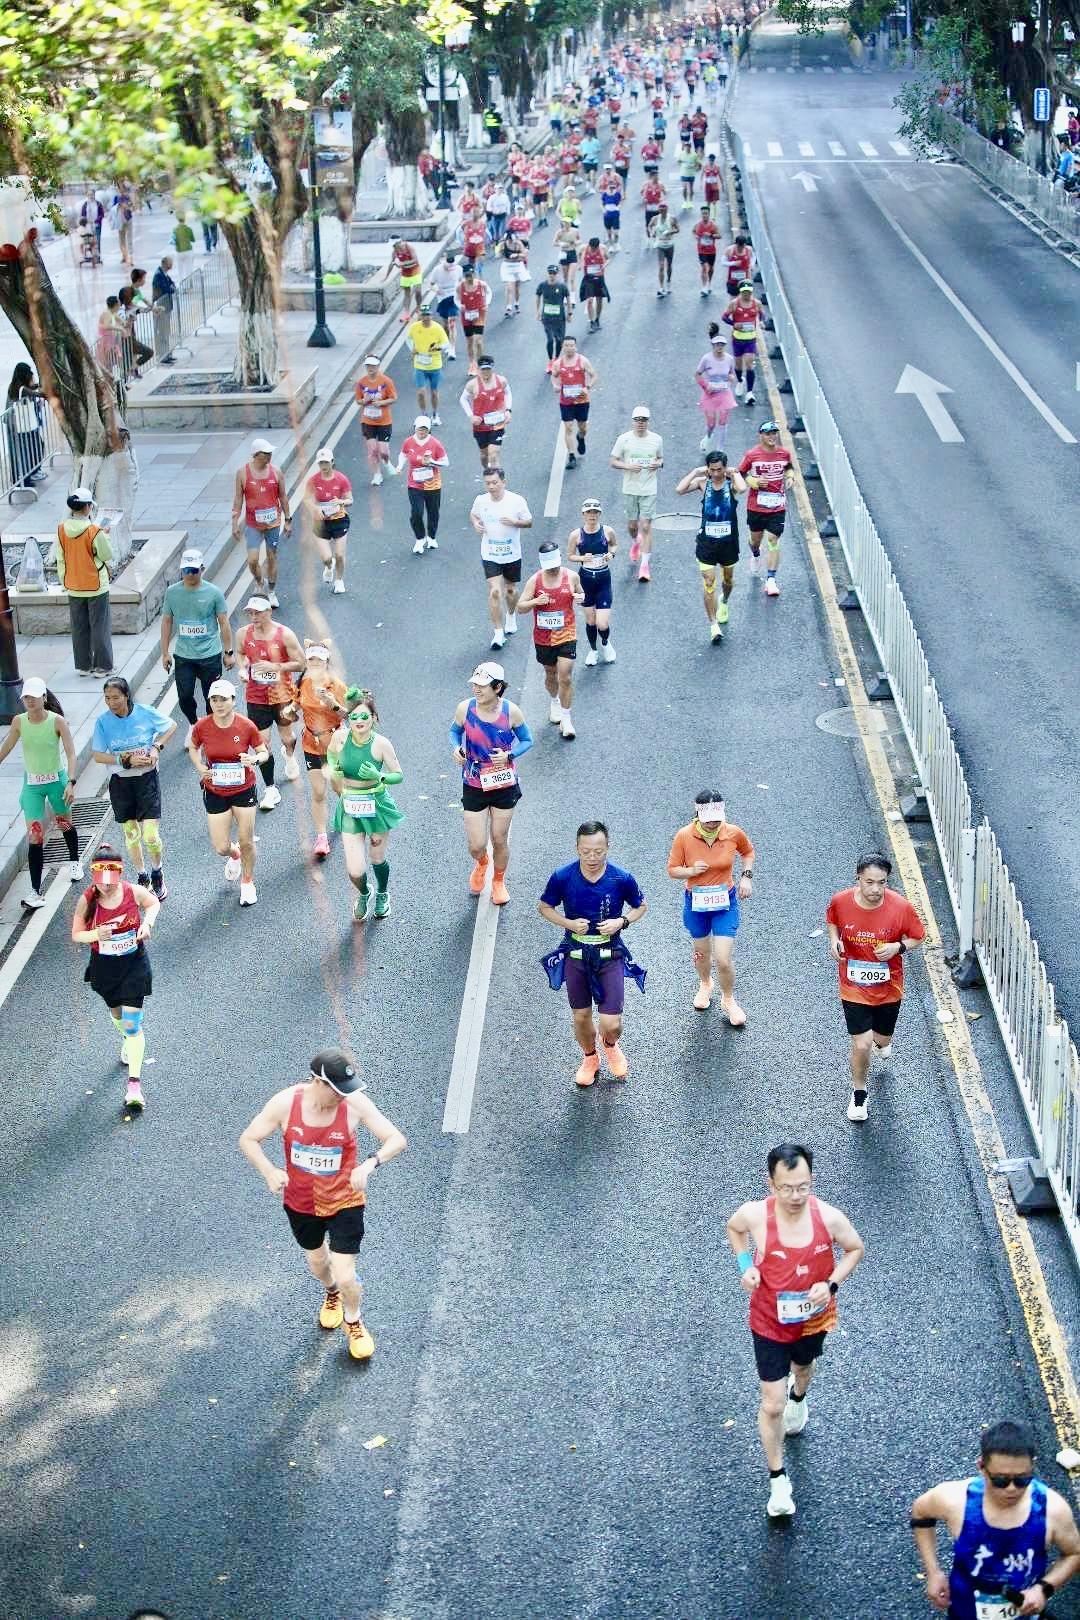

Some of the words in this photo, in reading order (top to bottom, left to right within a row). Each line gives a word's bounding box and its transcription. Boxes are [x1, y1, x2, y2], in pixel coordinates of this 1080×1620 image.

[492, 771, 511, 783] 3629
[703, 894, 726, 904] 9135
[860, 971, 886, 980] 2092
[309, 1156, 334, 1168] 1511
[970, 1544, 1035, 1577] 广州
[999, 1607, 1017, 1619] 10
